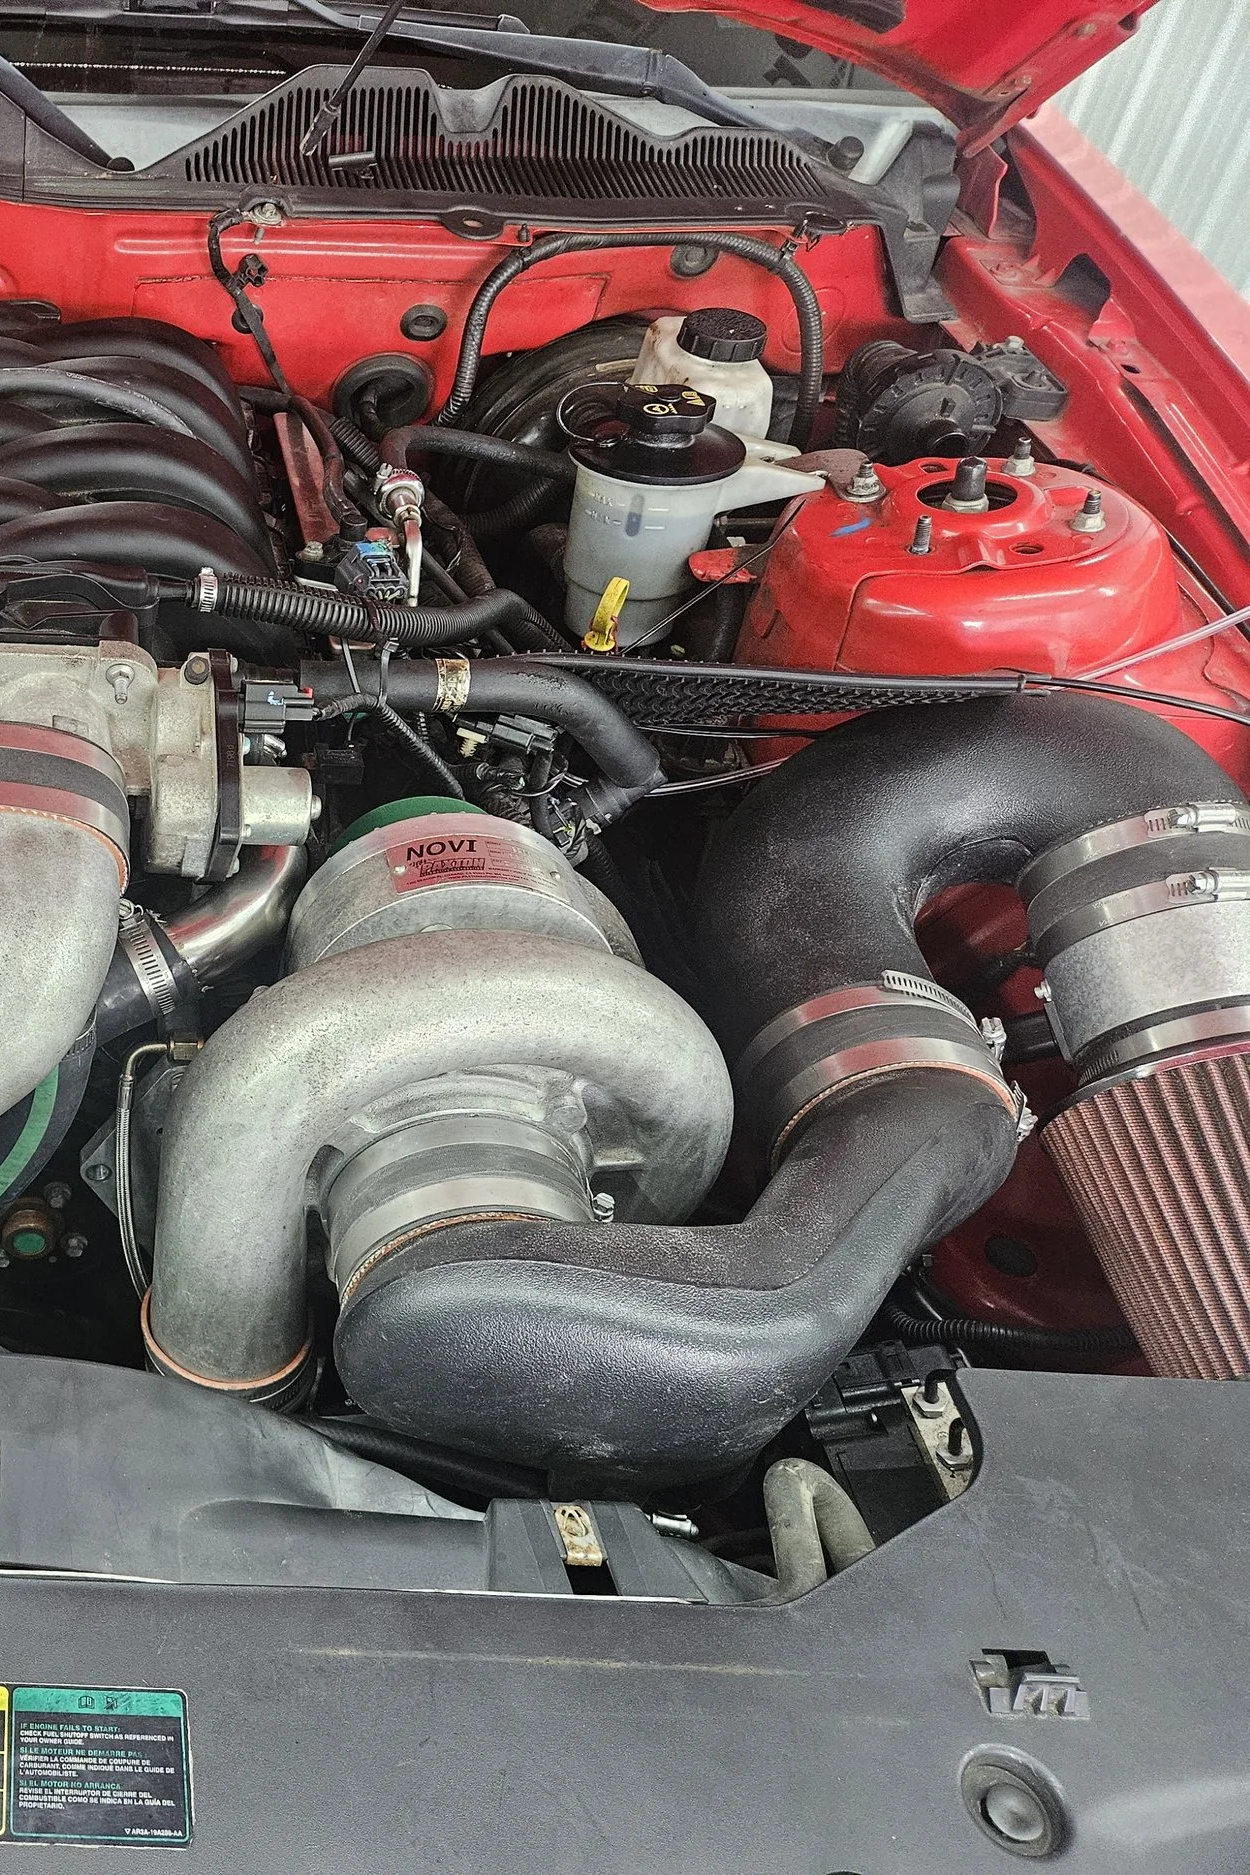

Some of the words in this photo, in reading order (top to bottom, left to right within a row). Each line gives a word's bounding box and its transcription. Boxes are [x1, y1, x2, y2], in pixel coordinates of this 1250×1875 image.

[406, 839, 477, 861] NOVI
[59, 1756, 97, 1764] COMMANDE
[19, 1769, 79, 1777] L'AUTOMOBILISTE.
[19, 1794, 66, 1802] COMBUSTIBLE
[19, 1801, 65, 1809] PROPIETARIO.
